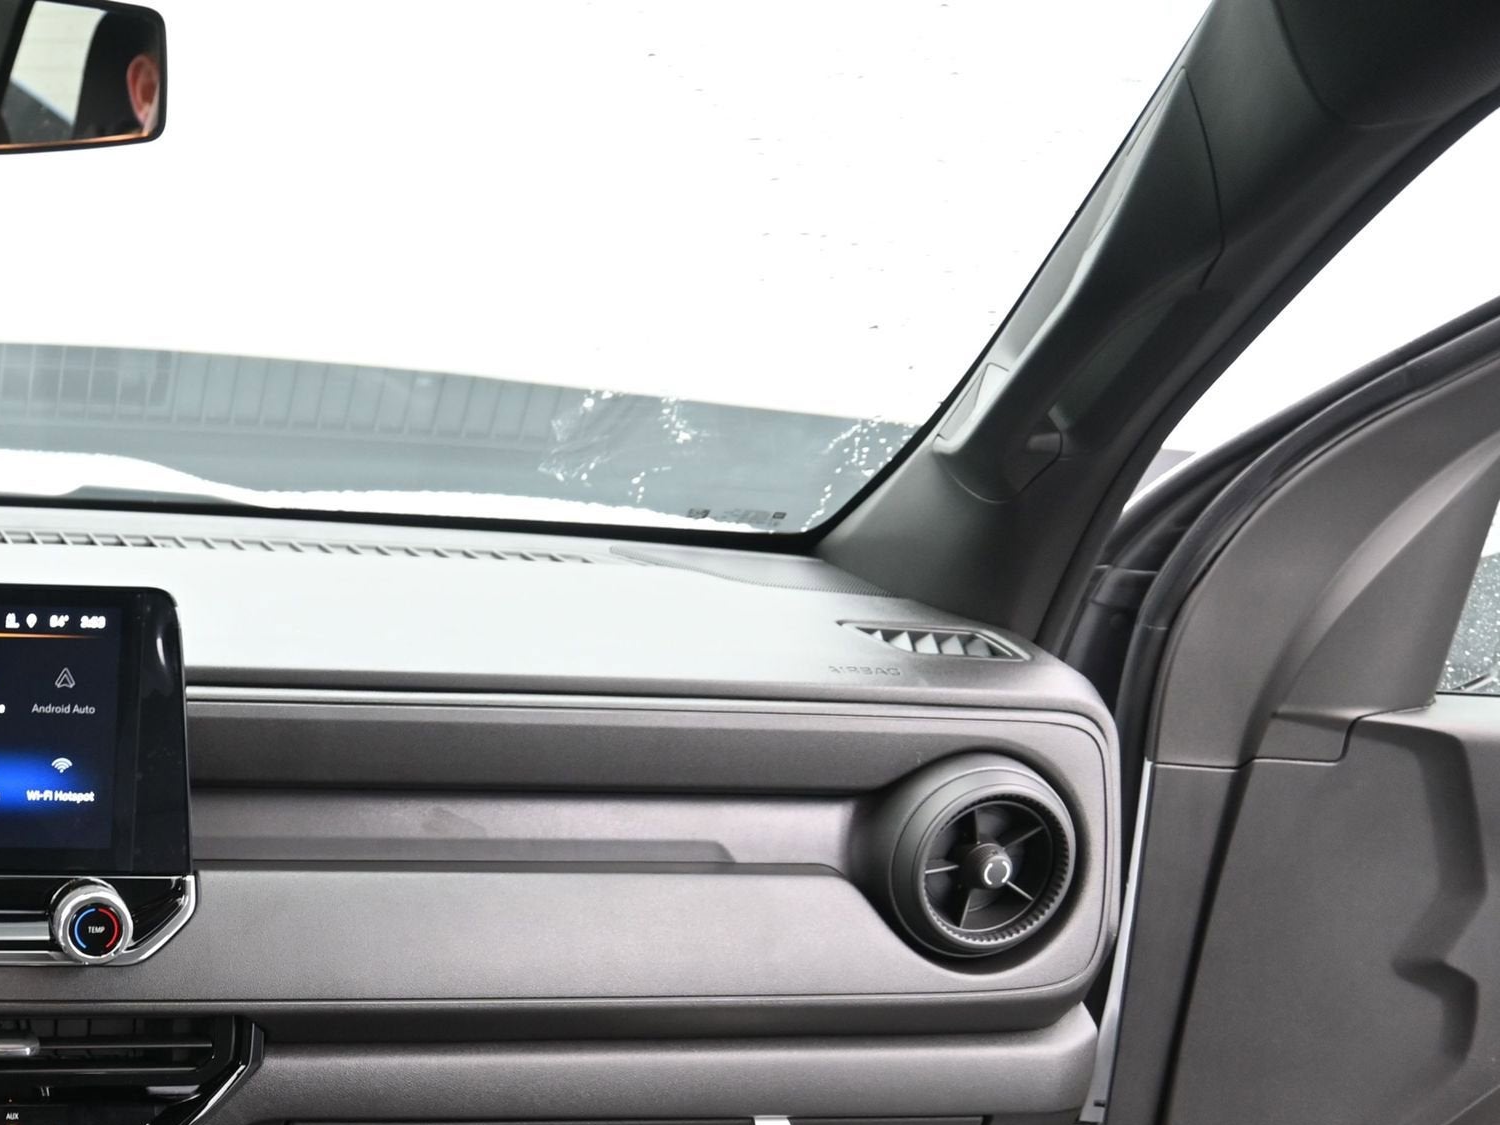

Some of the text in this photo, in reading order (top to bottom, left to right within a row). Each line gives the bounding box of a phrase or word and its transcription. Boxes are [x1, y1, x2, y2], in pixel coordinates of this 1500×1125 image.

[828, 664, 900, 676] AIRBAG
[31, 703, 96, 715] Android Auto
[26, 789, 96, 804] Wi-Fi Hotspot
[88, 926, 106, 934] TEMP
[5, 1112, 20, 1121] AUX
